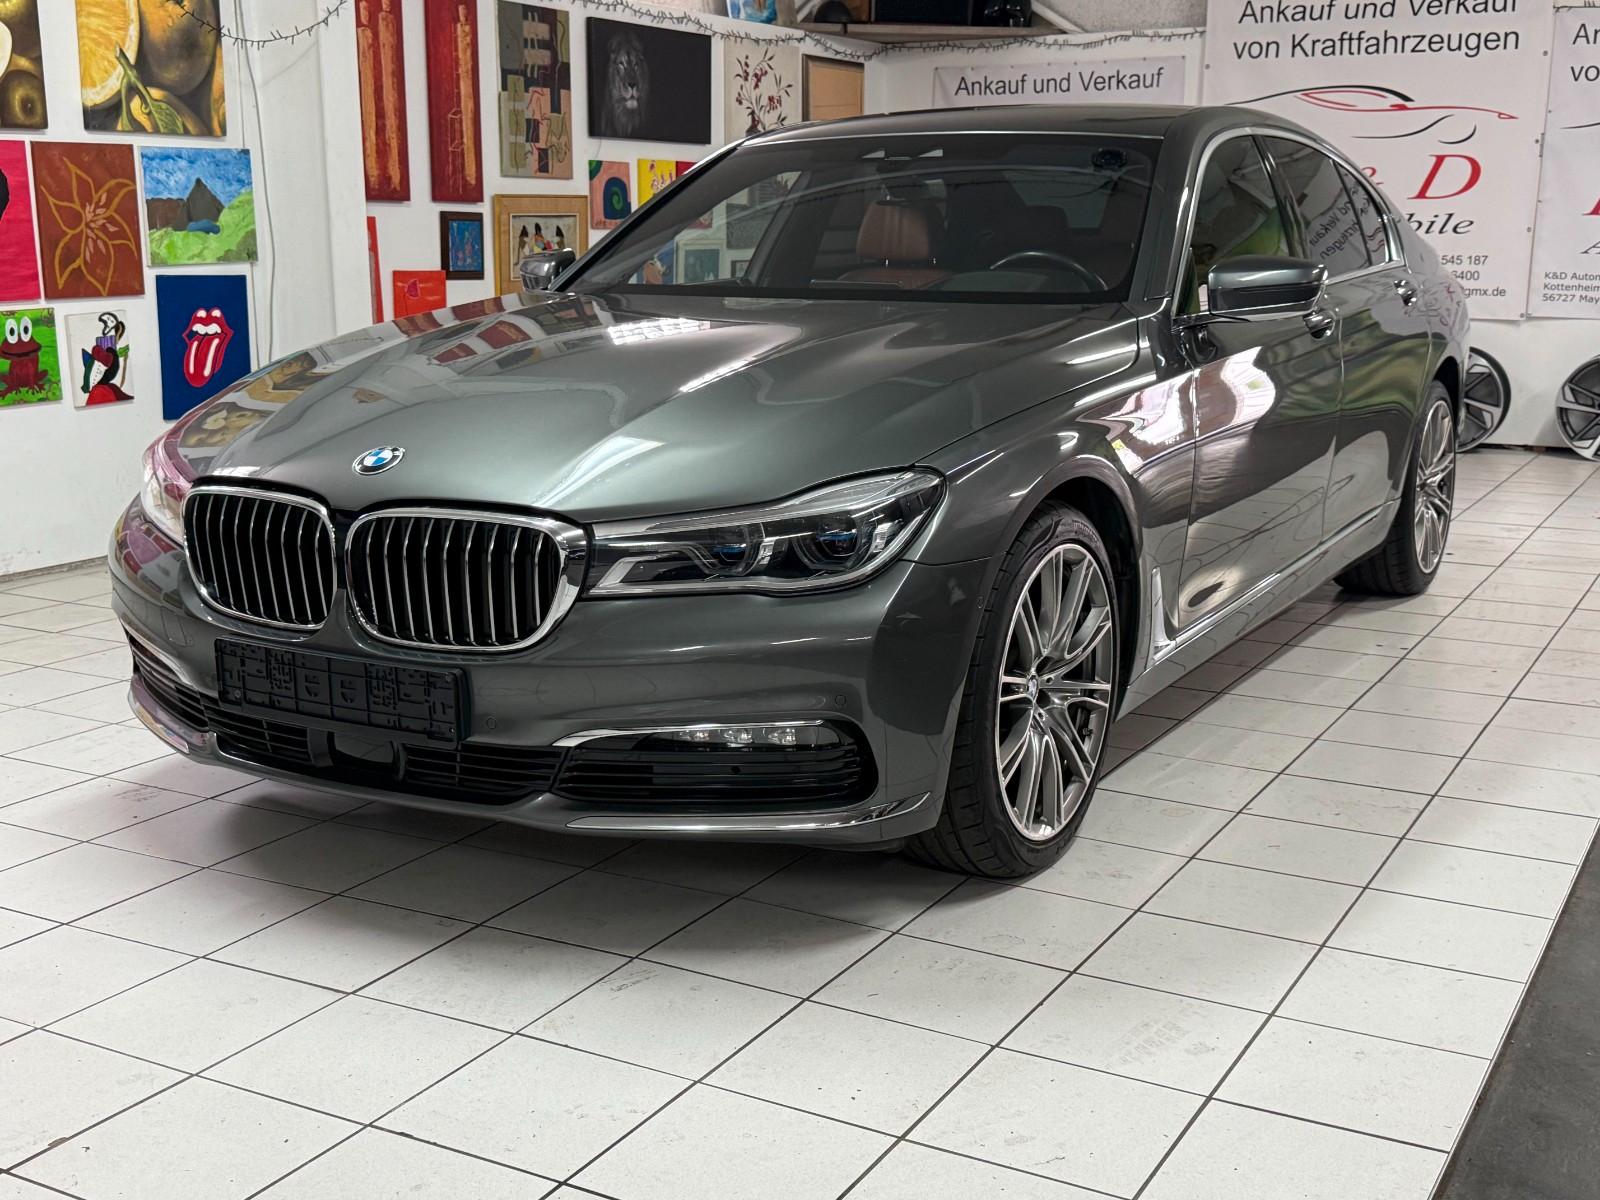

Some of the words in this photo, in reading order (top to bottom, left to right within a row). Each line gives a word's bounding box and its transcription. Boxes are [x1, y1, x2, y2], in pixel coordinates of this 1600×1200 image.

[1238, 0, 1337, 24] Ankauf
[1344, 0, 1396, 19] und
[1233, 41, 1280, 60] von
[1291, 30, 1520, 58] Kraftfahrzeugen
[954, 73, 1028, 96] Ankauf
[1033, 72, 1072, 94] und
[1079, 66, 1165, 92] Verkauf
[1407, 153, 1482, 200] D
[1404, 212, 1476, 235] bile
[1440, 254, 1464, 266] 545
[1467, 254, 1489, 266] 187
[1544, 271, 1568, 281] K&D
[1462, 286, 1507, 298] gmx.de
[1542, 293, 1577, 303] 56727
